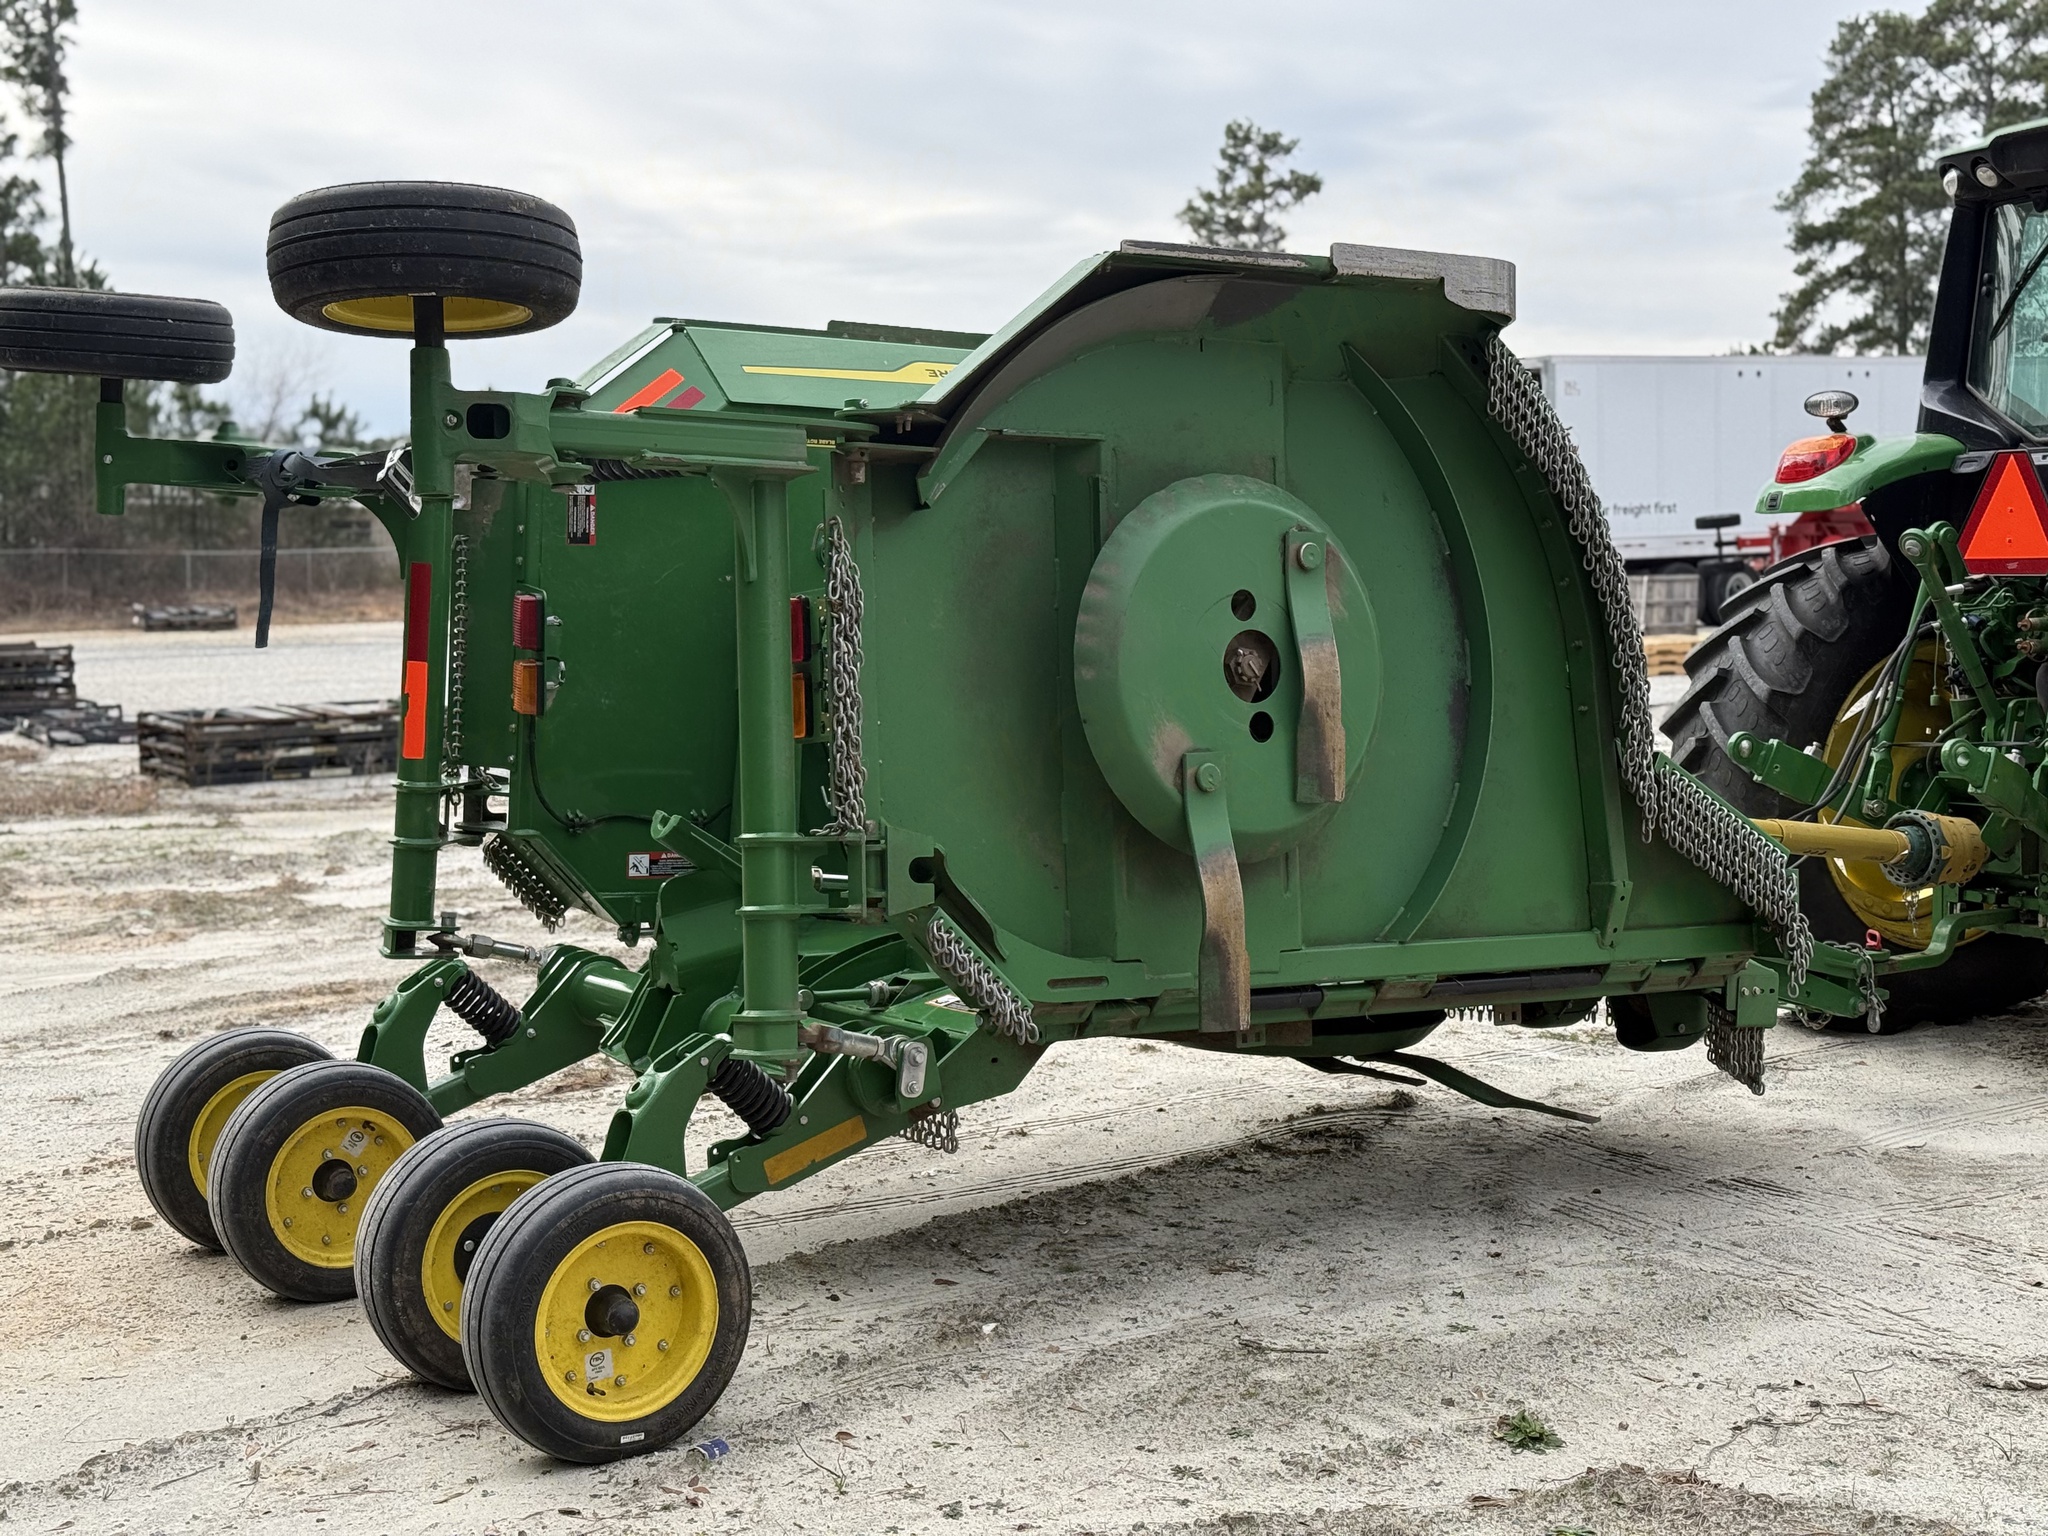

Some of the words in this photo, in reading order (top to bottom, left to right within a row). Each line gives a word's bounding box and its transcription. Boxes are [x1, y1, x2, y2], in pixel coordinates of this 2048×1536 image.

[925, 368, 949, 378] RE
[1613, 503, 1651, 518] freight
[1654, 502, 1677, 514] first
